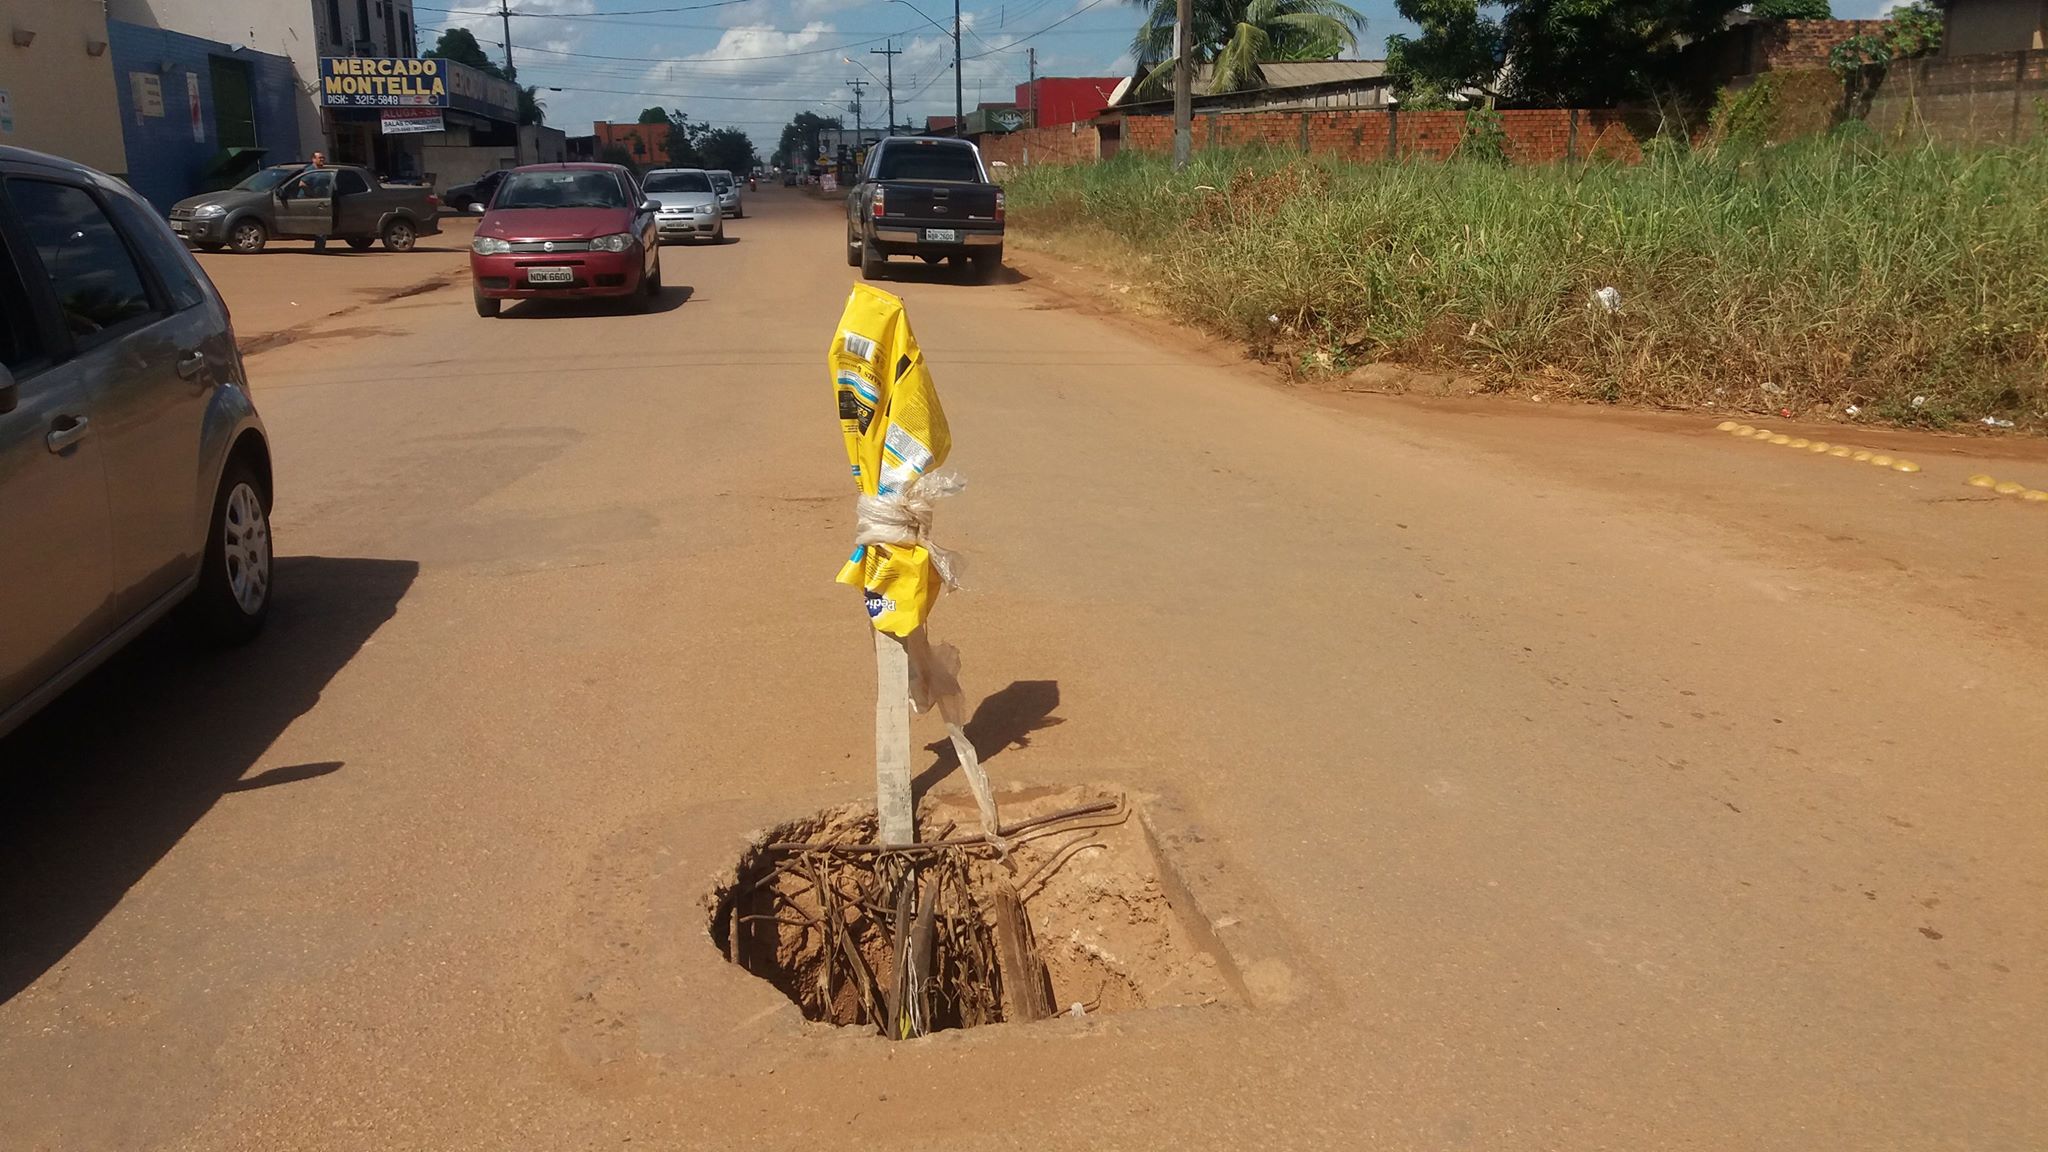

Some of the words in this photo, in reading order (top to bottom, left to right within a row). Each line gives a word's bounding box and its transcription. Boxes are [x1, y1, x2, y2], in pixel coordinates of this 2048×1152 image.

[332, 59, 437, 75] MERCADO
[325, 76, 445, 96] MONTELLA
[327, 94, 349, 104] DISK:
[354, 95, 399, 105] 3215-5848
